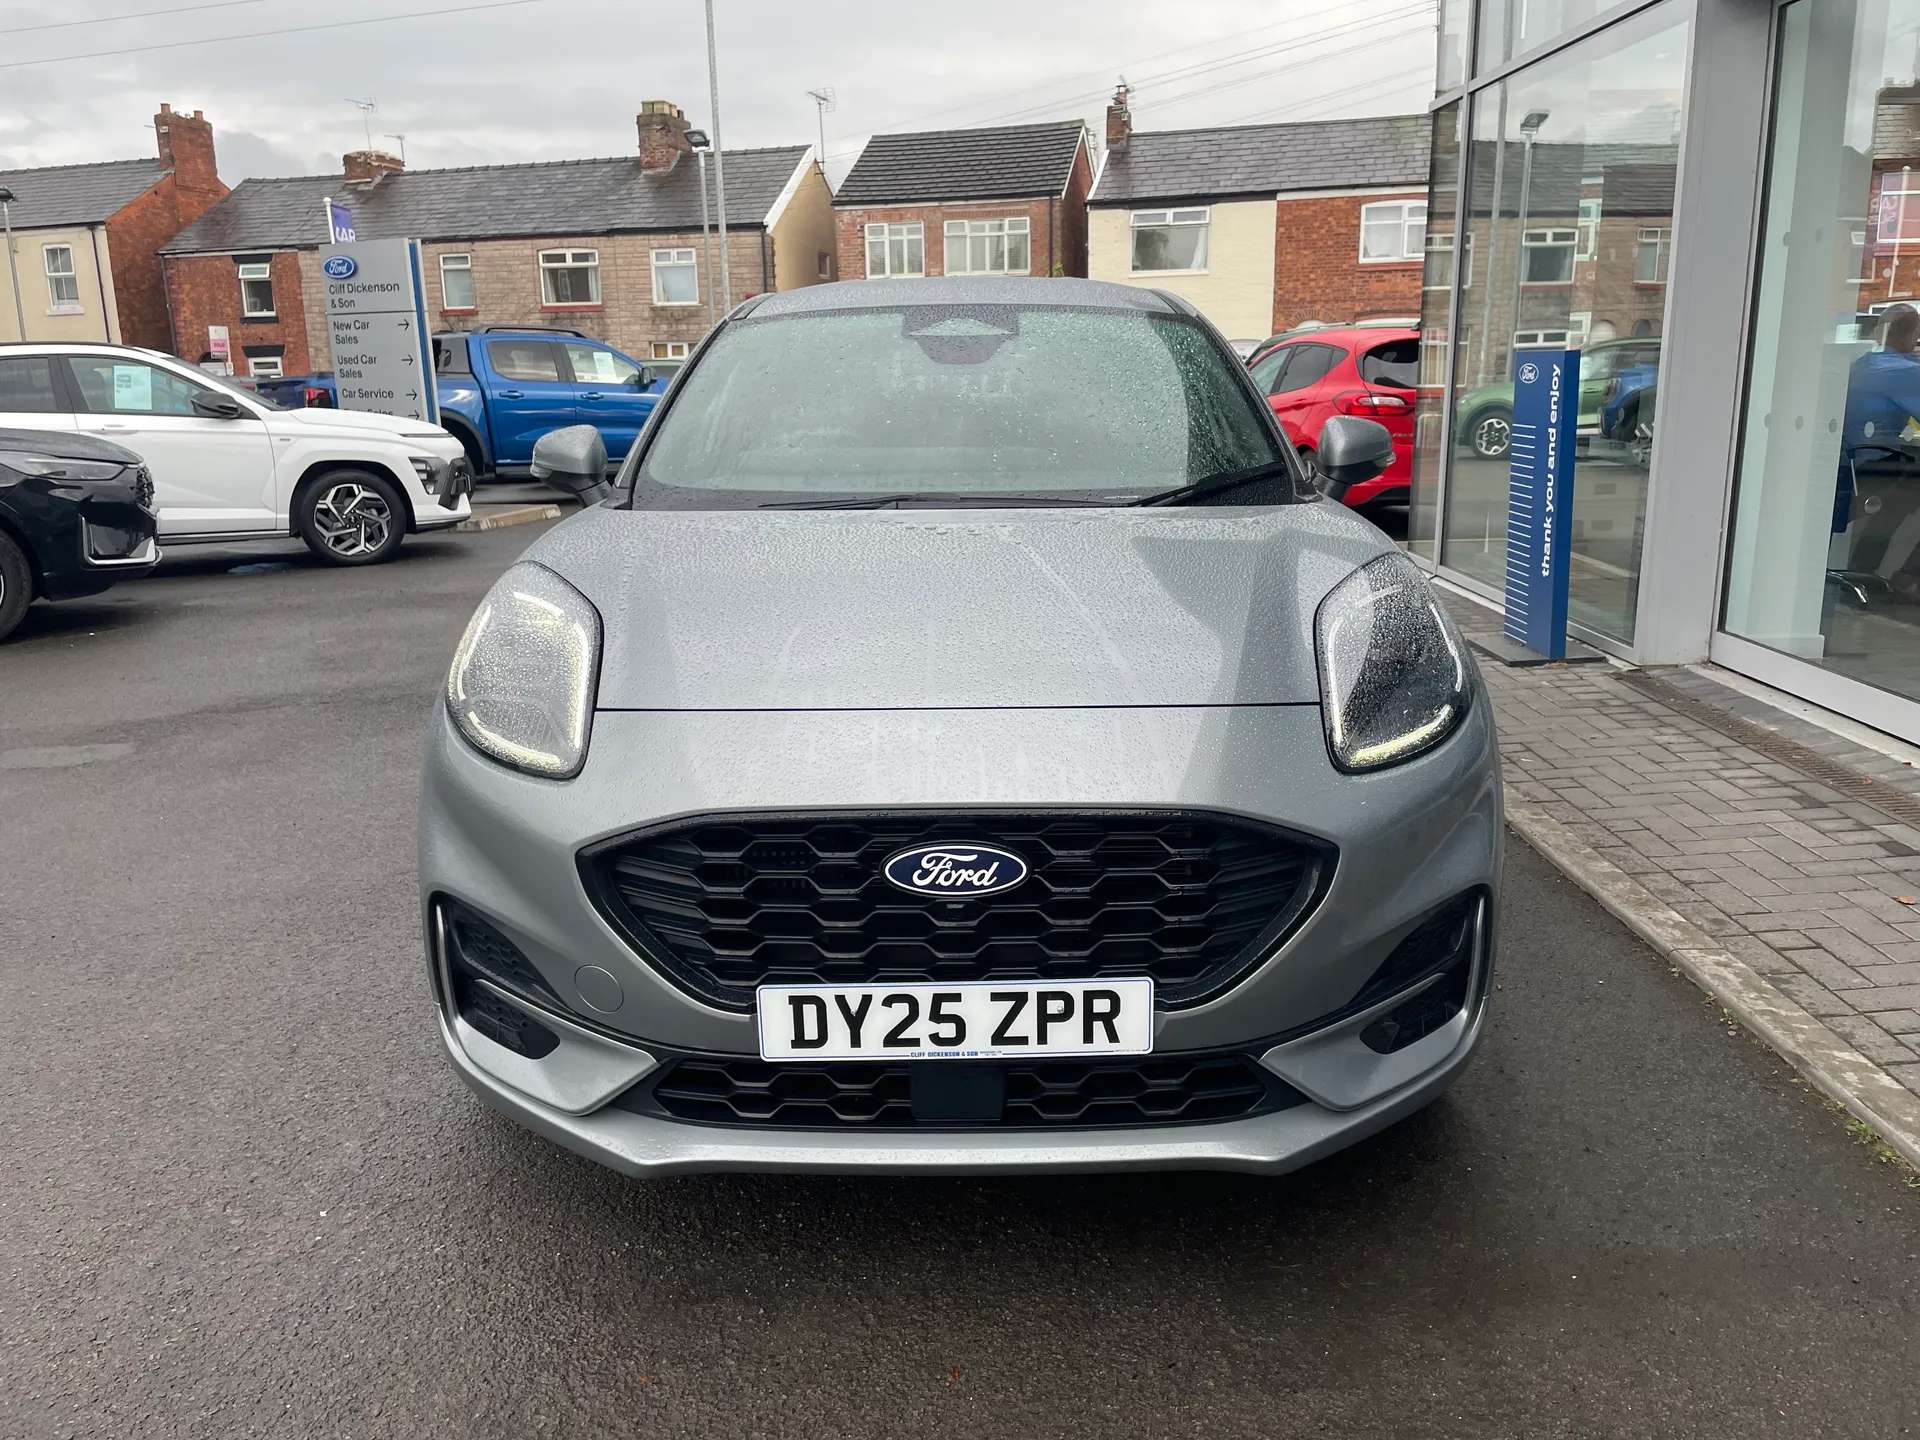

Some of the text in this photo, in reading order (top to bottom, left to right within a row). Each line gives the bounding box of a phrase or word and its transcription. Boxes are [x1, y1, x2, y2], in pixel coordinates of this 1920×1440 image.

[335, 227, 356, 242] CAR
[329, 282, 400, 295] Cliff Dickenson
[331, 298, 356, 308] & Son
[333, 320, 370, 331] New Car
[335, 334, 359, 344] Sales
[337, 354, 377, 365] Used Car
[339, 368, 363, 379] Sales
[341, 388, 394, 398] Car Service
[1541, 363, 1561, 577] thank you and enjoy
[912, 852, 1000, 887] Ford
[788, 989, 1121, 1049] DY25 ZPR
